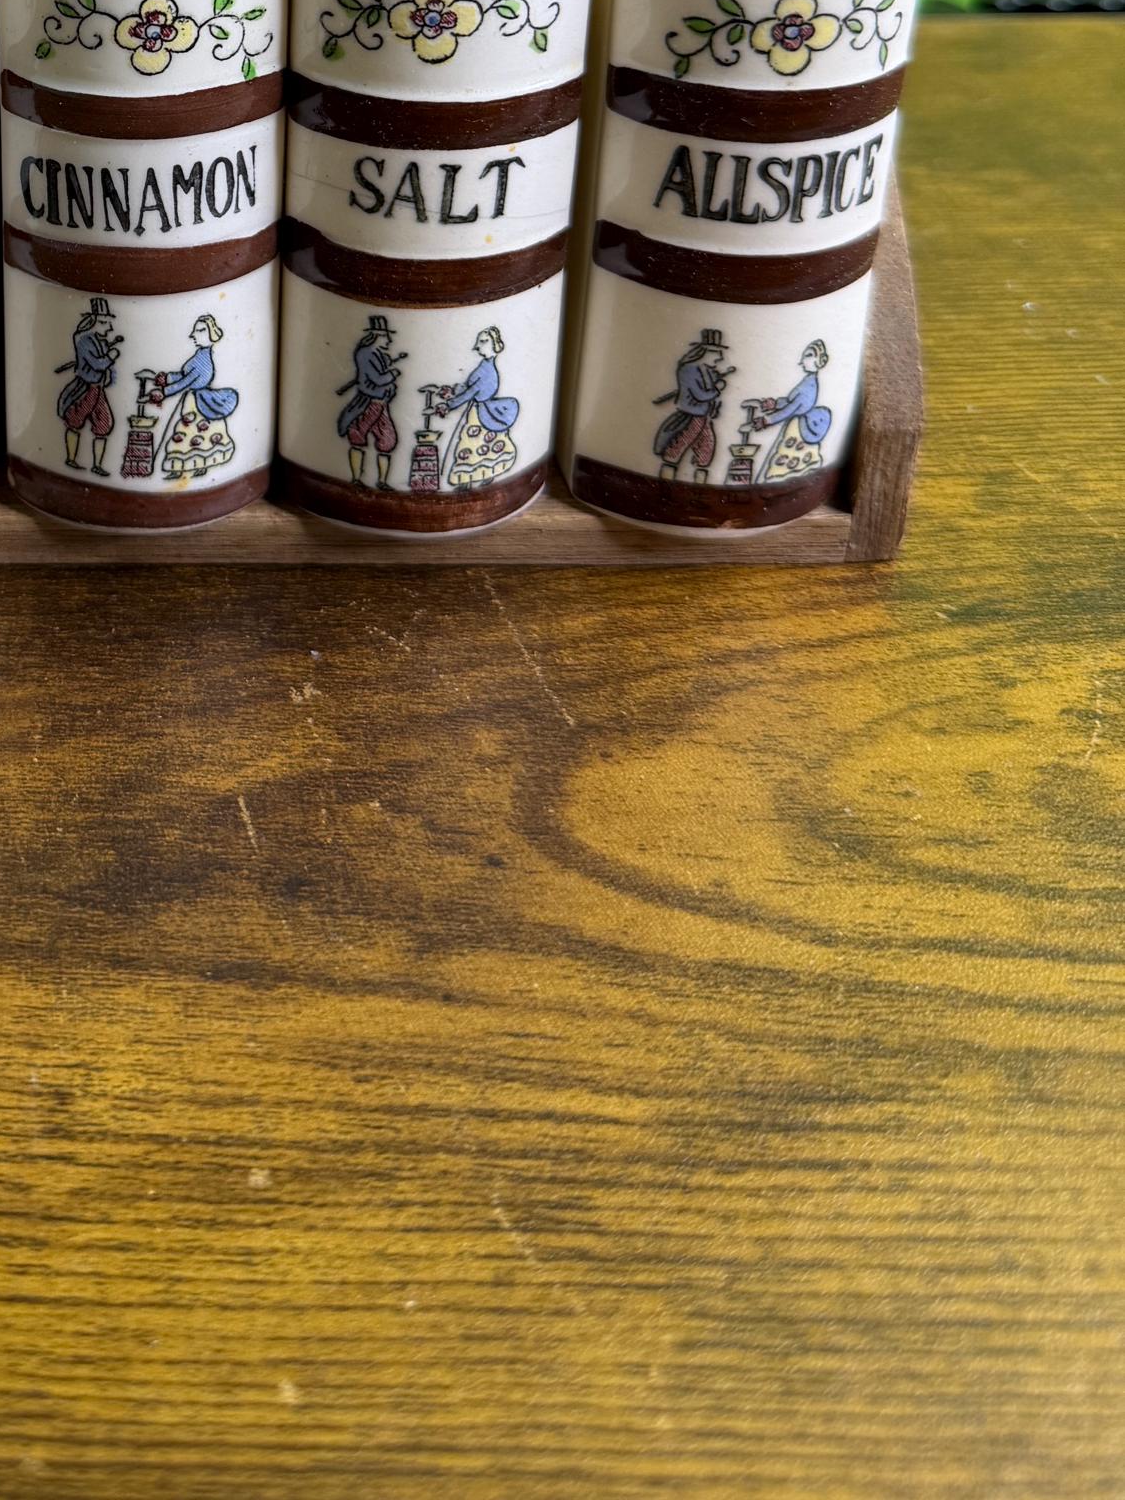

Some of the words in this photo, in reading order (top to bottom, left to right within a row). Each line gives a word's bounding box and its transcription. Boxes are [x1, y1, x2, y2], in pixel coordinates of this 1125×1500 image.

[19, 145, 259, 237] CINNAMON
[348, 155, 527, 226] SALT
[652, 133, 884, 225] ALLSPICE
